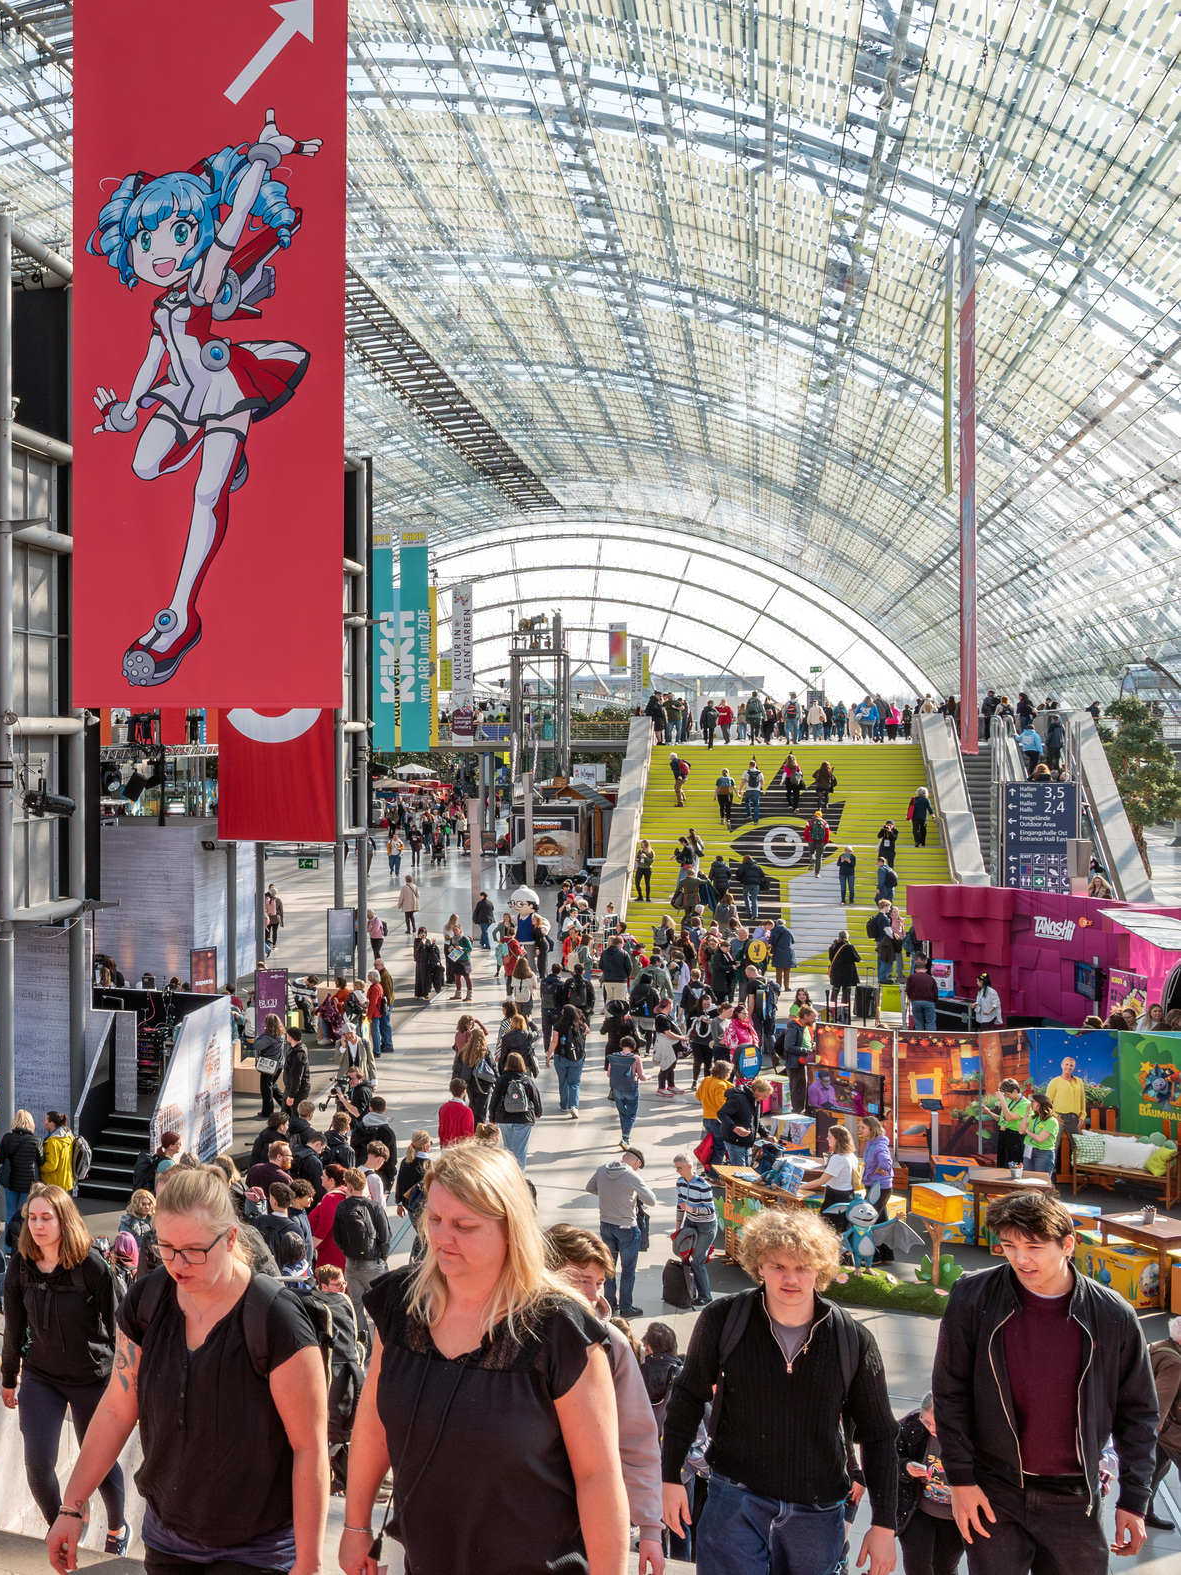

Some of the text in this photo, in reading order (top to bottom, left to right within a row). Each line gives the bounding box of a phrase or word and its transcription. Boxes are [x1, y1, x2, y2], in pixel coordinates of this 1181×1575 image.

[417, 609, 429, 630] ZDF
[463, 609, 471, 649] FARBEN
[418, 634, 429, 654] und
[454, 629, 462, 681] KULTUR IN
[418, 657, 429, 680] ARD
[463, 651, 472, 681] ALLEN
[1044, 786, 1065, 800] 3,5
[1044, 801, 1066, 815] 2,4
[194, 979, 214, 987] aspekte
[259, 998, 278, 1007] BUCH
[1139, 1103, 1181, 1121] BAUMHAU
